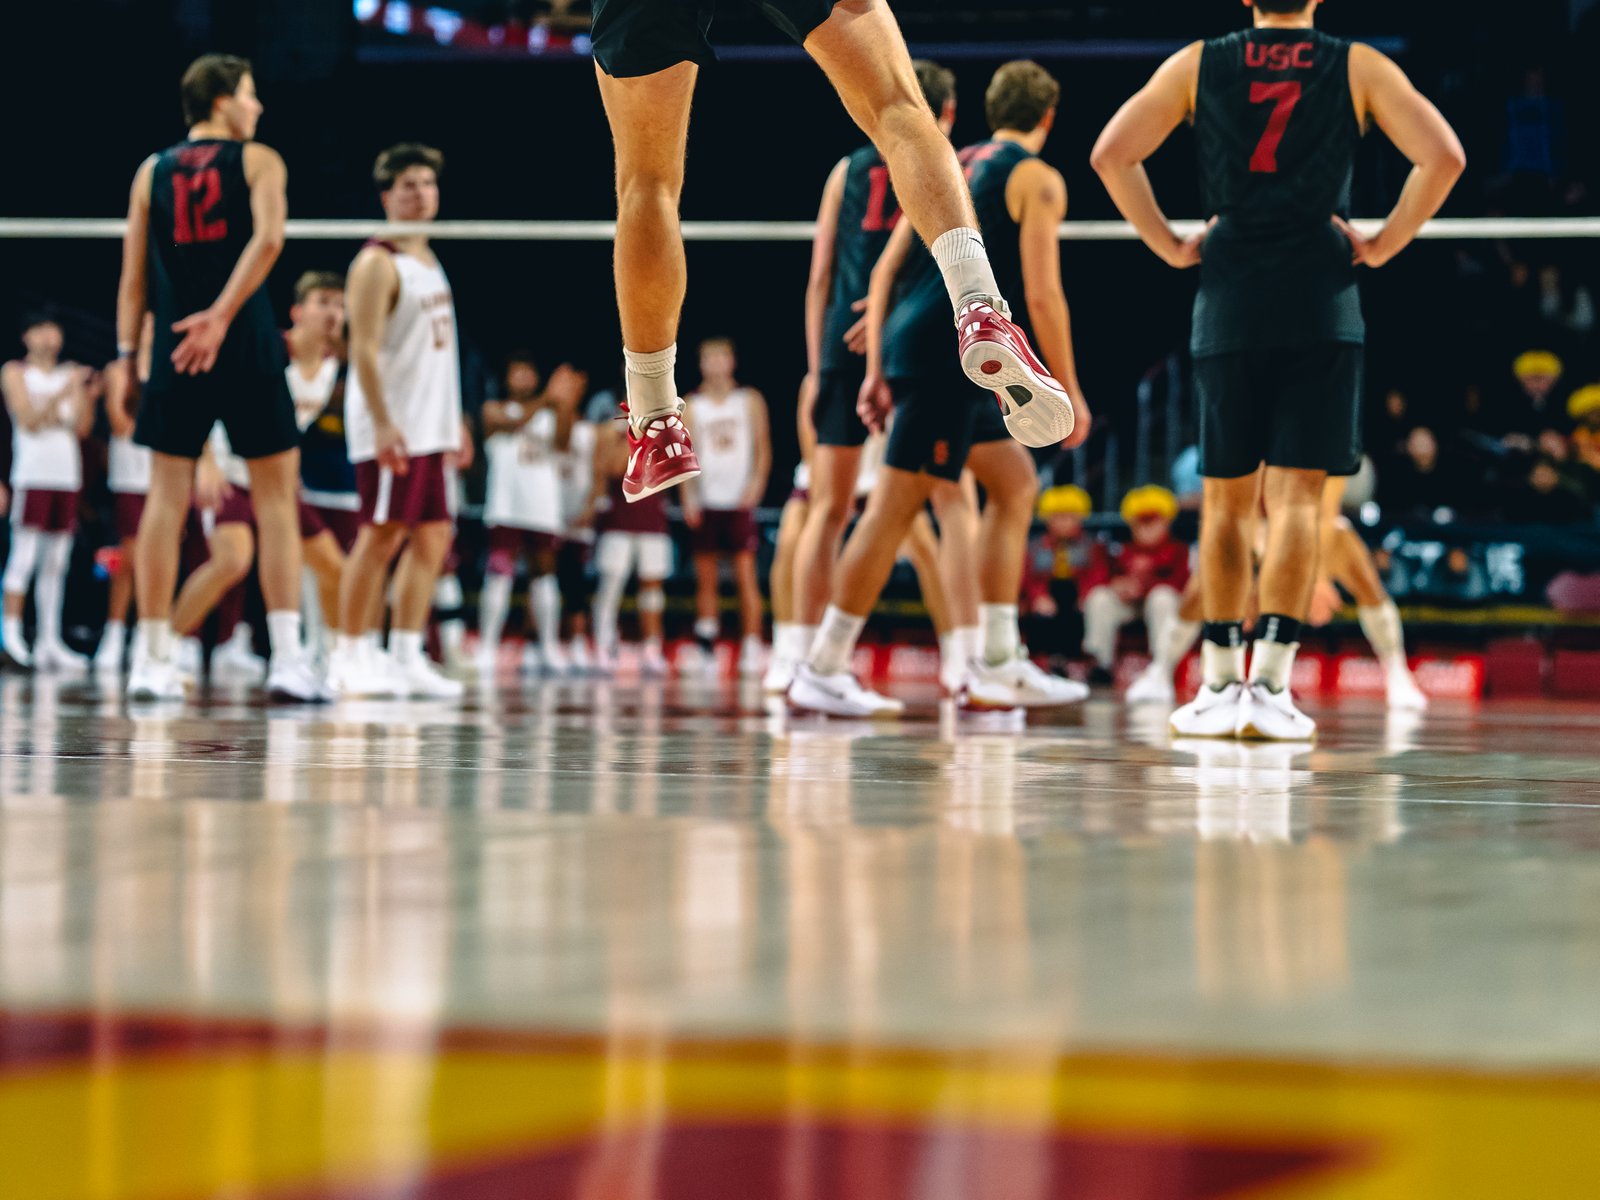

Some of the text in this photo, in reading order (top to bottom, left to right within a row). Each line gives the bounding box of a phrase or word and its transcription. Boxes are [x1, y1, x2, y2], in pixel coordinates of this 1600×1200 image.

[1245, 41, 1313, 70] USC
[1249, 80, 1301, 173] 7
[171, 167, 228, 244] 12
